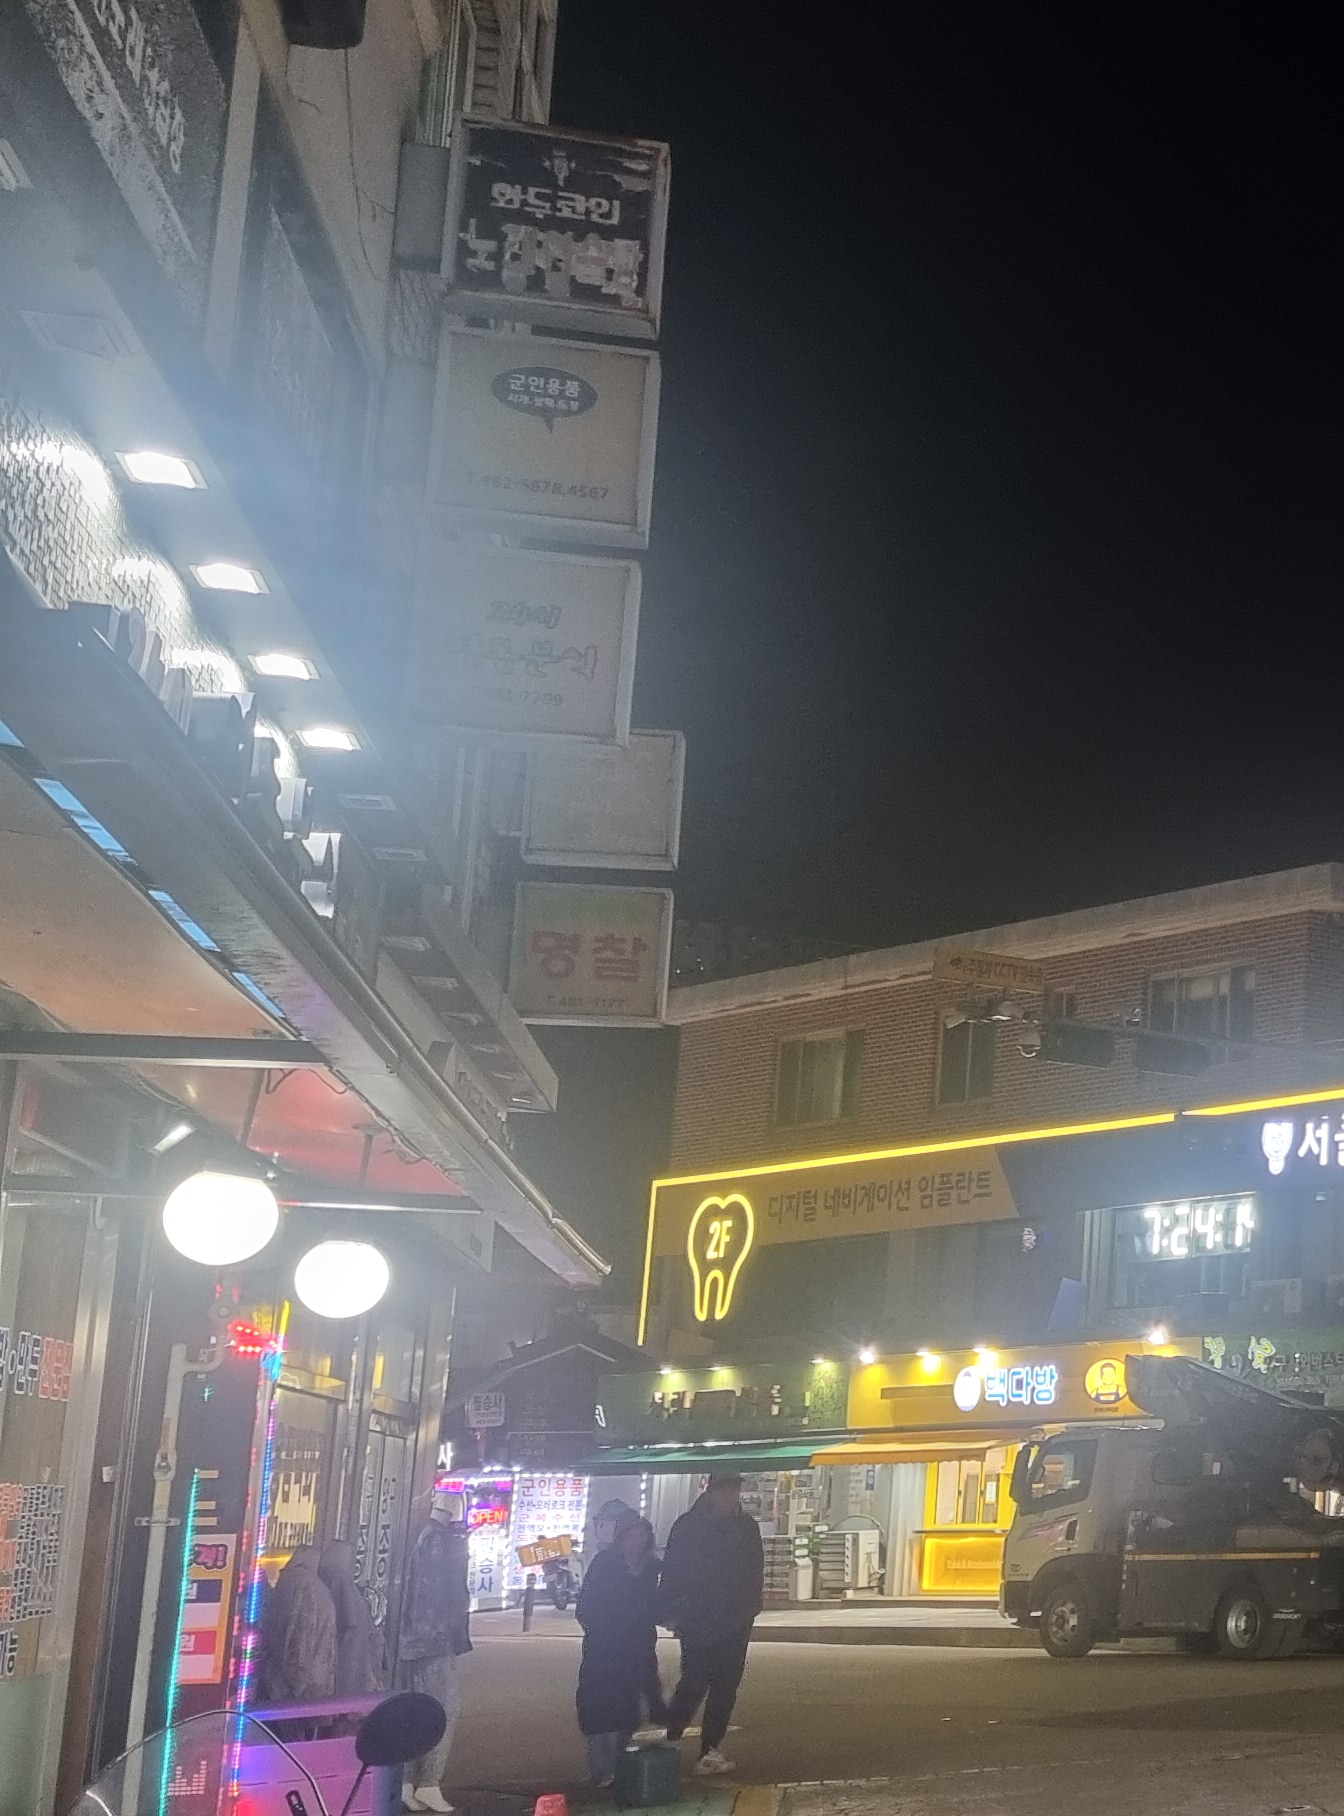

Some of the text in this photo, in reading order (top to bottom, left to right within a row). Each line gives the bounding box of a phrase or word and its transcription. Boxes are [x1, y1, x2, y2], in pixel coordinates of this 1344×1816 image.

[508, 374, 581, 398] 군인용품
[531, 931, 650, 983] 명찰
[768, 1170, 993, 1224] 디지털 네비게이션 임플란트
[706, 1219, 732, 1259] 2F
[520, 1478, 584, 1498] 군인용품
[472, 1509, 504, 1524] OPEN
